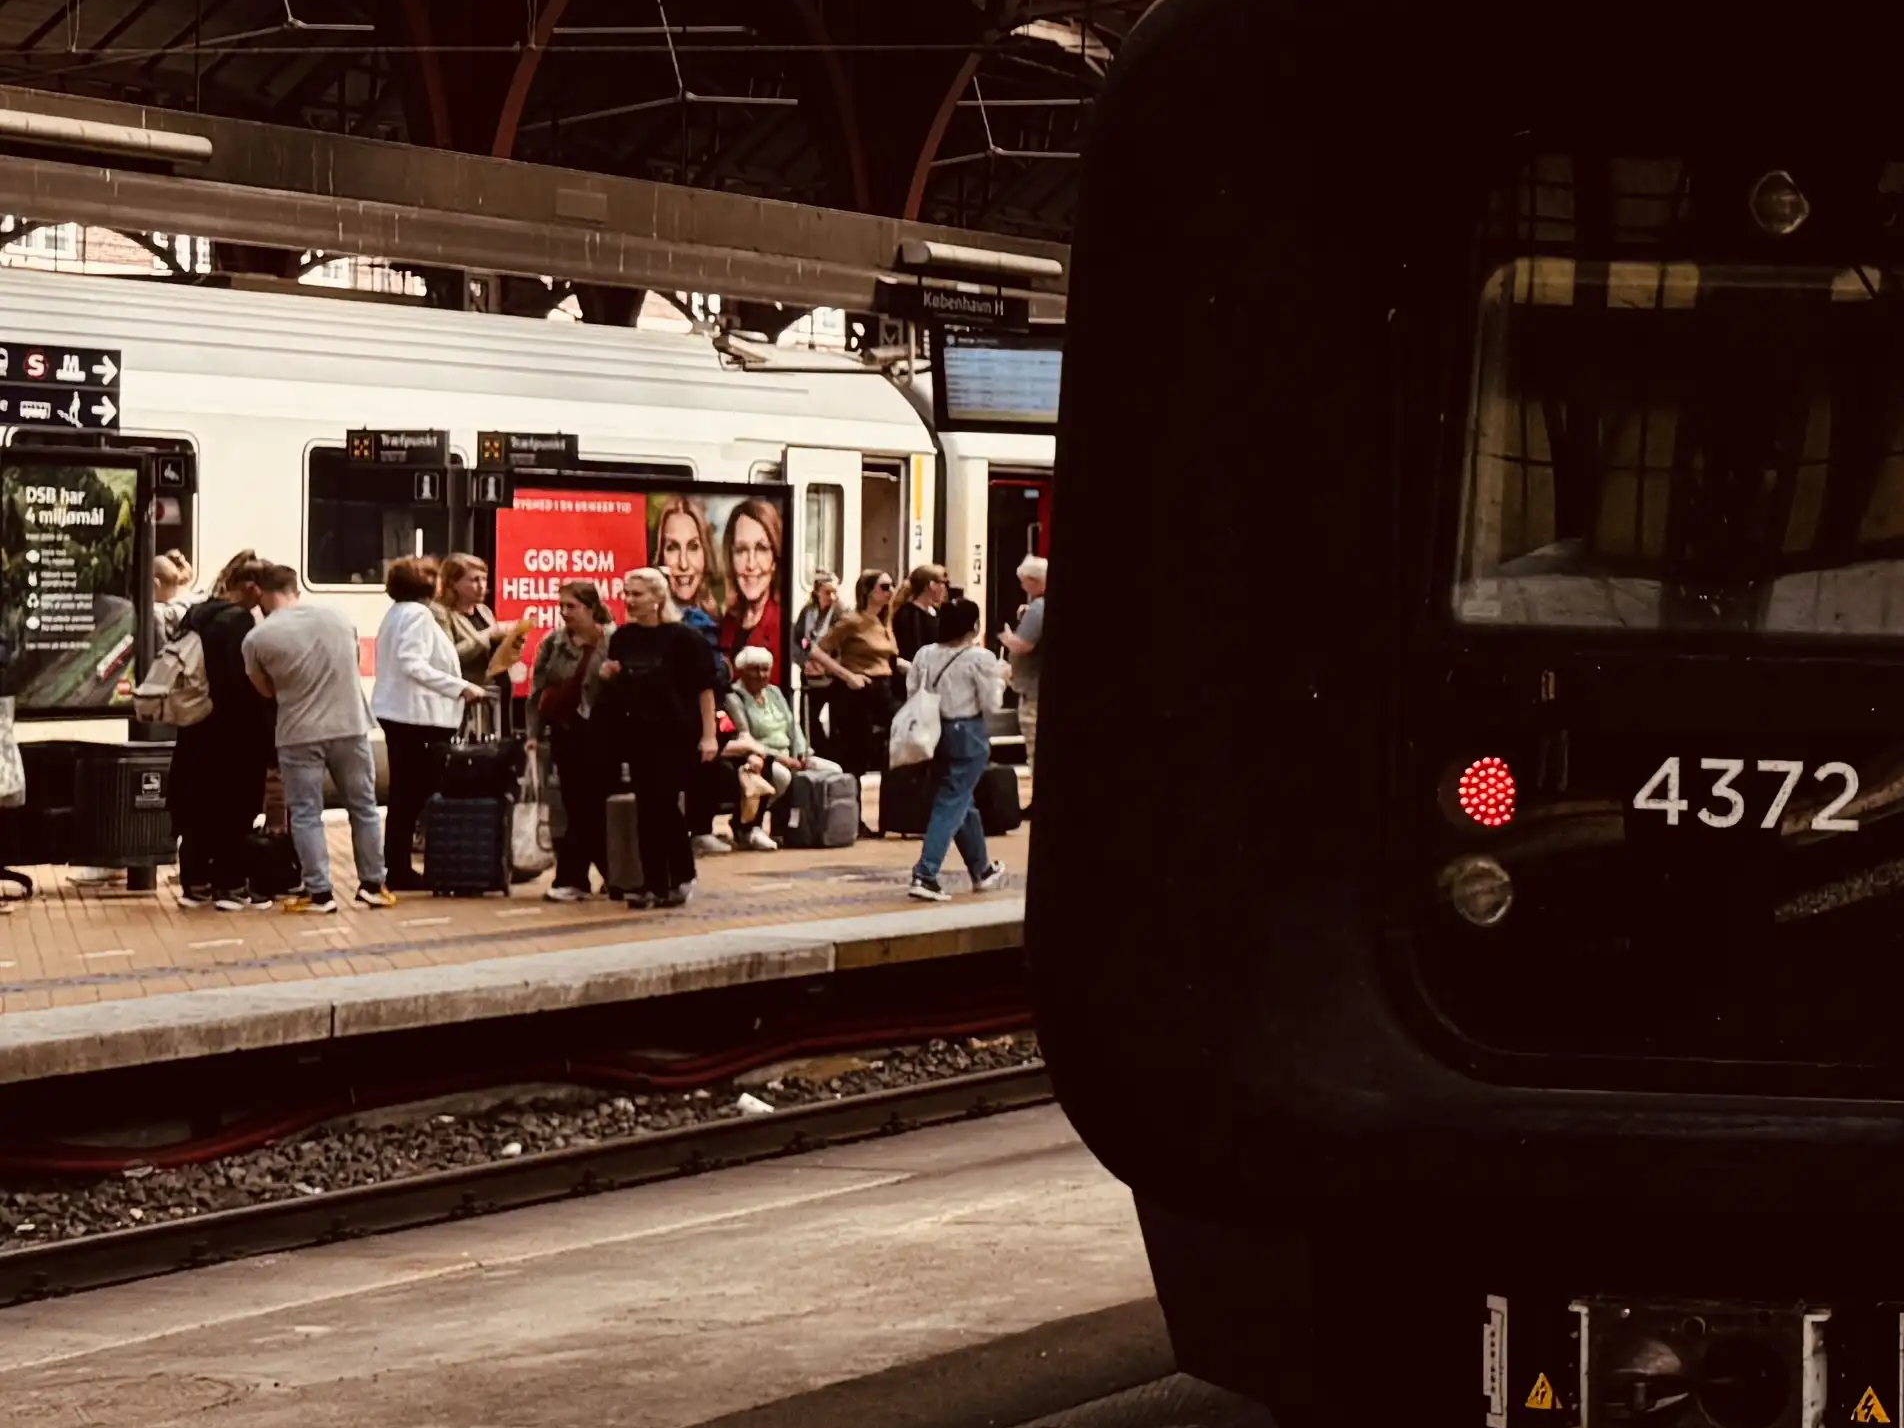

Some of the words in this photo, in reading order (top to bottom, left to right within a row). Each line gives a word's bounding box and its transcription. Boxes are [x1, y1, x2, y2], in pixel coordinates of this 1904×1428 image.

[923, 291, 992, 314] København
[994, 299, 1004, 316] H
[25, 486, 57, 504] DSB
[60, 487, 86, 505] har
[25, 507, 36, 524] 4
[572, 549, 615, 572] SOM
[502, 577, 561, 601] HELLE
[1632, 755, 1861, 833] 4372
